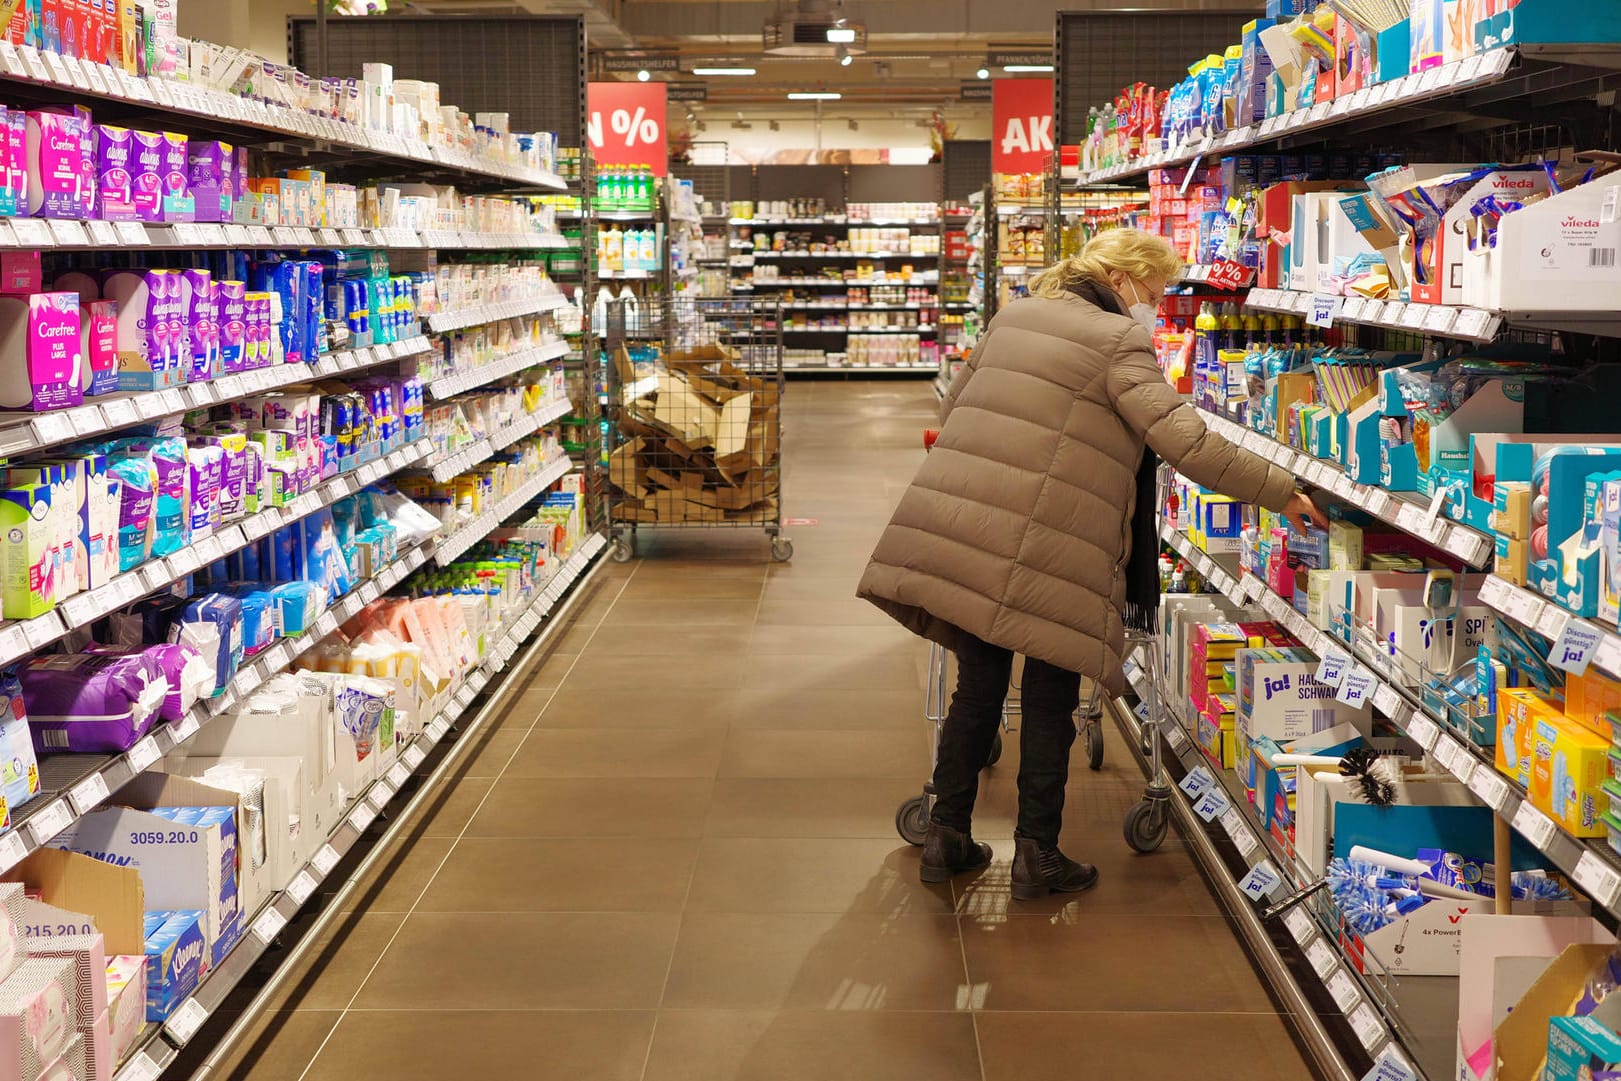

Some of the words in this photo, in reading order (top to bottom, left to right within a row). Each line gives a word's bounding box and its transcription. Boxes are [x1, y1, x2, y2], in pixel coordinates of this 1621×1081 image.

[156, 11, 173, 21] Gel
[611, 106, 659, 147] %
[51, 136, 75, 151] Carefree
[1492, 175, 1534, 189] vileda
[1561, 216, 1600, 228] vileda
[1315, 310, 1329, 322] ja!
[38, 321, 76, 338] Carefree
[52, 342, 64, 350] PLUS
[51, 351, 66, 360] LARGE
[1561, 647, 1584, 664] ja!
[1323, 668, 1338, 679] ja!
[1263, 673, 1292, 700] ja!
[1346, 688, 1362, 700] ja!
[1186, 780, 1200, 791] ja!
[1200, 803, 1214, 814] ja!
[130, 831, 198, 845] 3059.20.0
[1246, 880, 1262, 892] ja!
